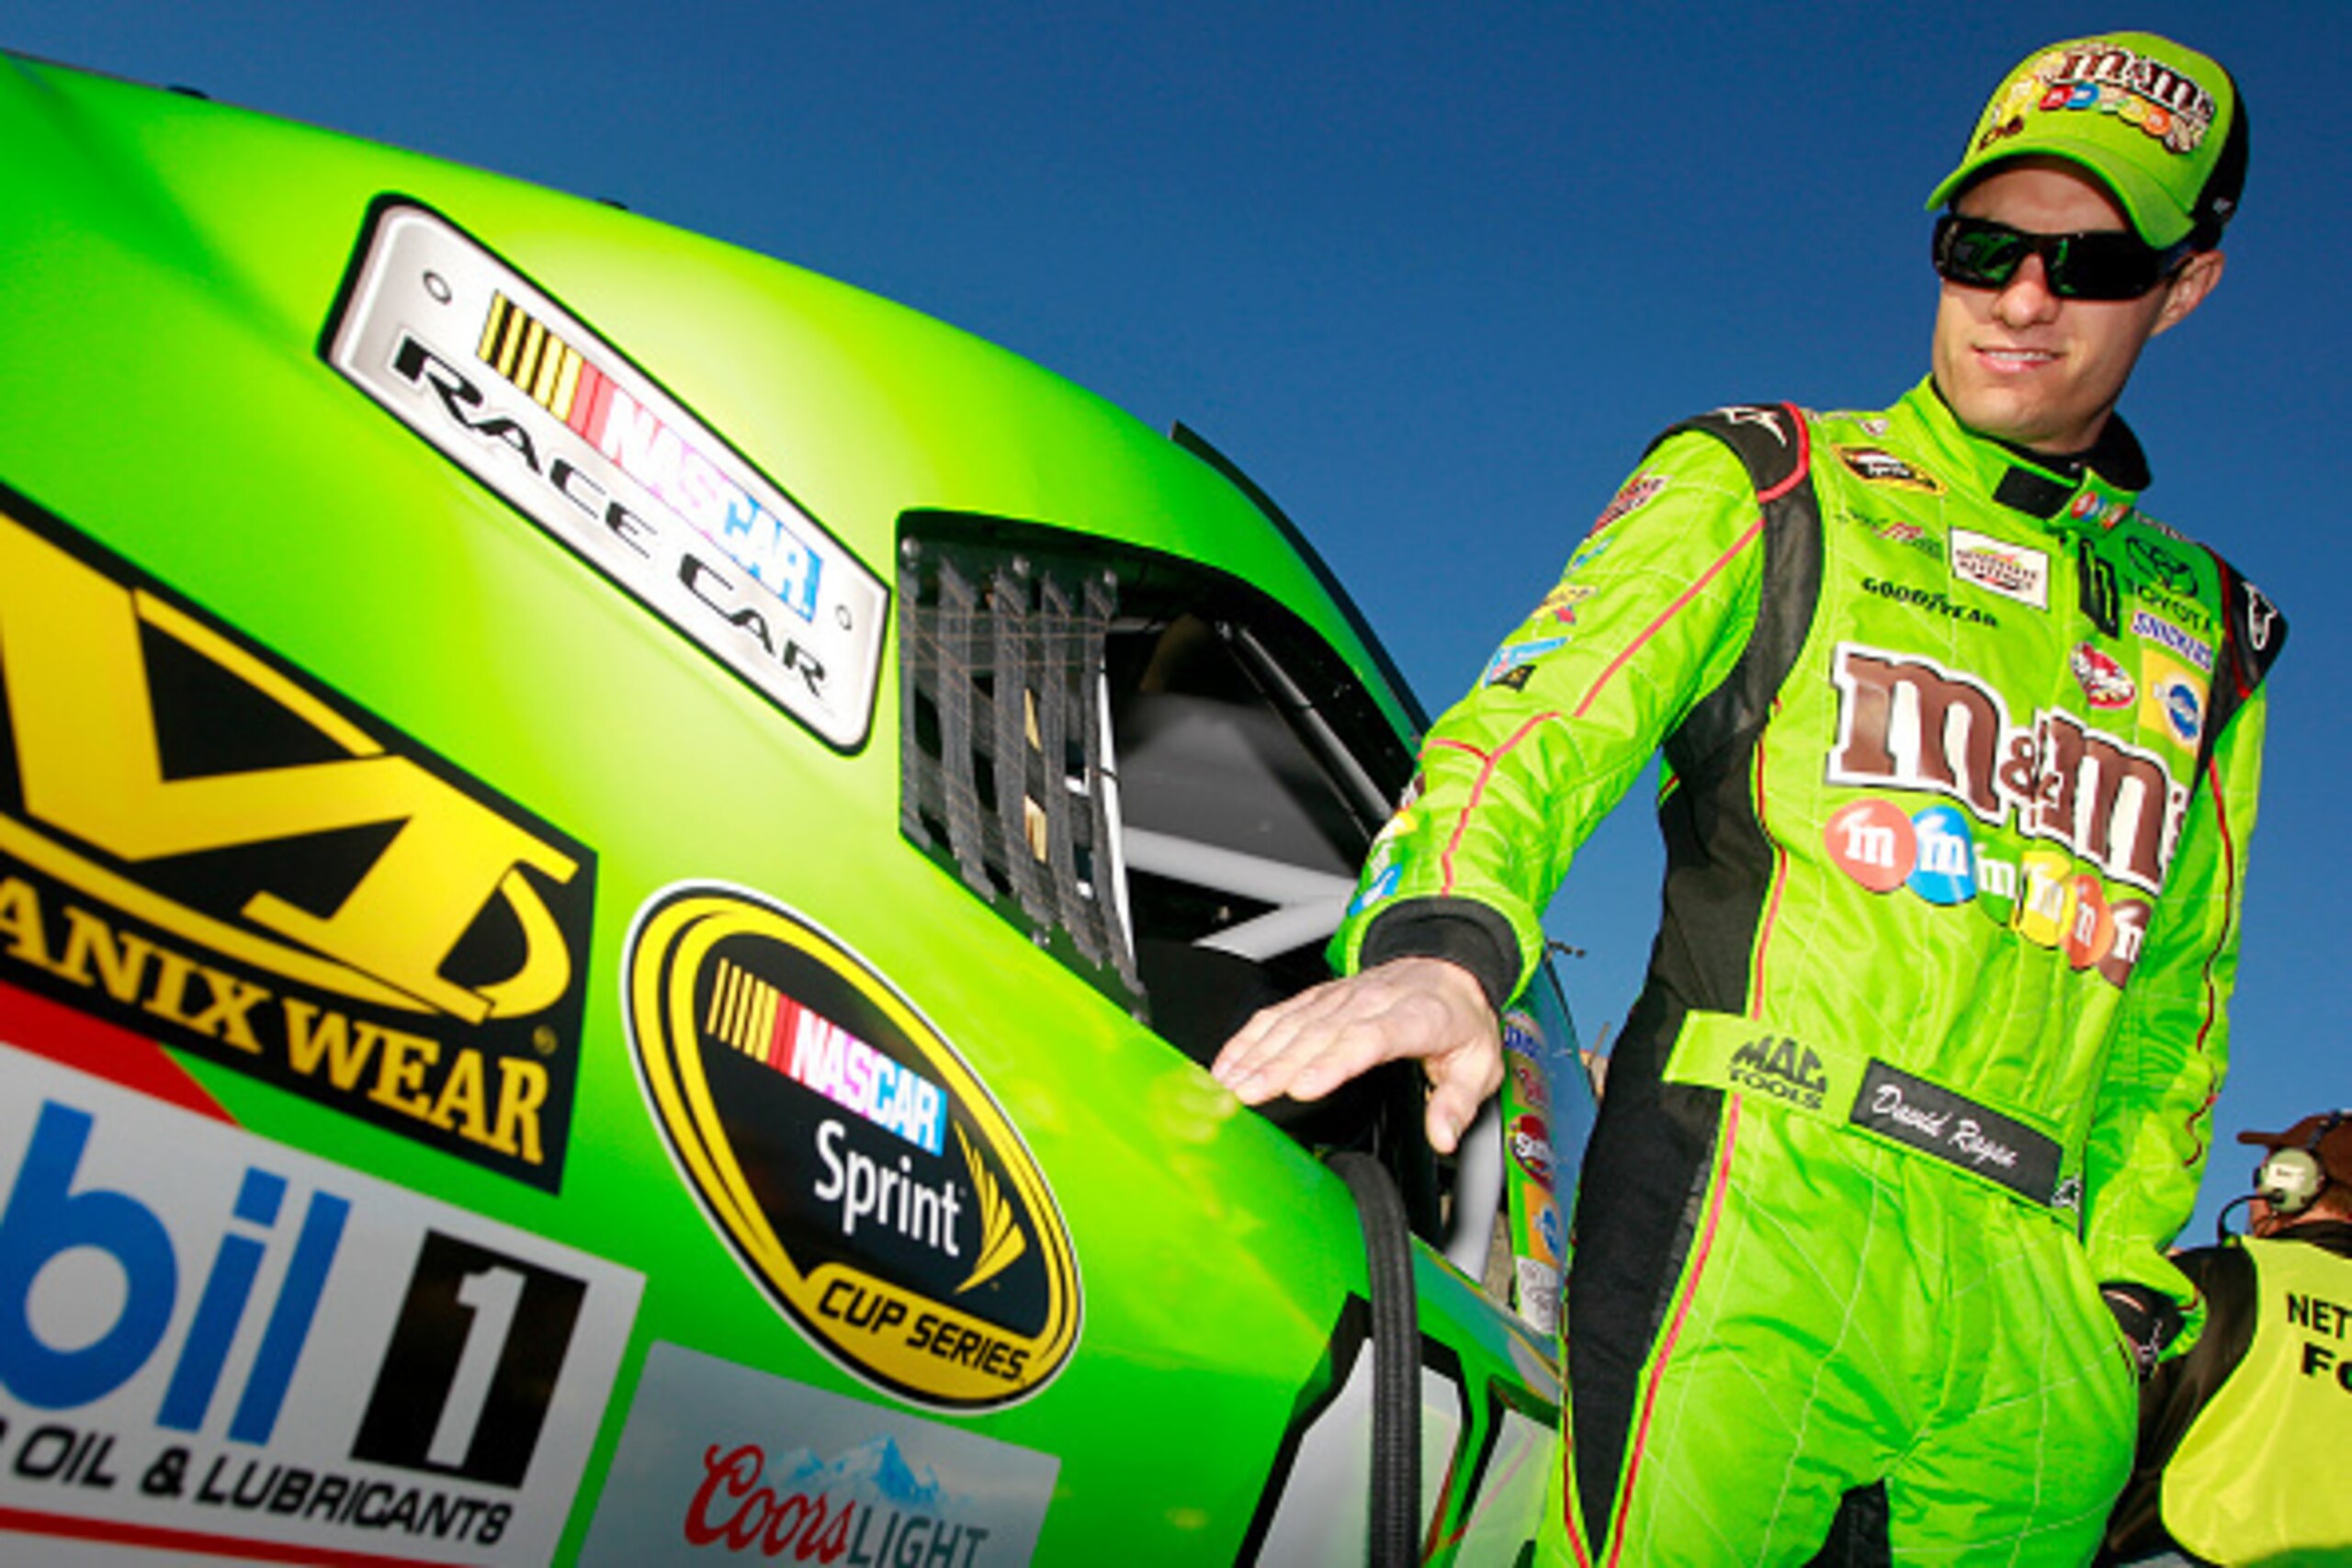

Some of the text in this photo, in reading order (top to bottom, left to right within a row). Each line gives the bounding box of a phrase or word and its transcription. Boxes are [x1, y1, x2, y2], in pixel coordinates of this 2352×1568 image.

[394, 336, 827, 697] RACE CAR
[595, 386, 820, 622] NASCAR
[1861, 577, 1998, 627] GOODYEAR
[281, 997, 548, 1165] WEAR
[788, 1007, 942, 1153] NASCAR
[1730, 1068, 1822, 1110] TOOLS
[1731, 1033, 1826, 1094] MAC
[1871, 1083, 1954, 1138] David
[814, 1119, 961, 1257] Sprint
[425, 1264, 527, 1467] 1
[818, 1279, 1031, 1382] CUP SERIES
[2286, 1292, 2352, 1339] NET
[15, 1425, 117, 1489] OIL
[140, 1446, 191, 1498] &
[195, 1455, 513, 1546] LUBRICANTS
[684, 1443, 989, 1568] Coors LIGHT
